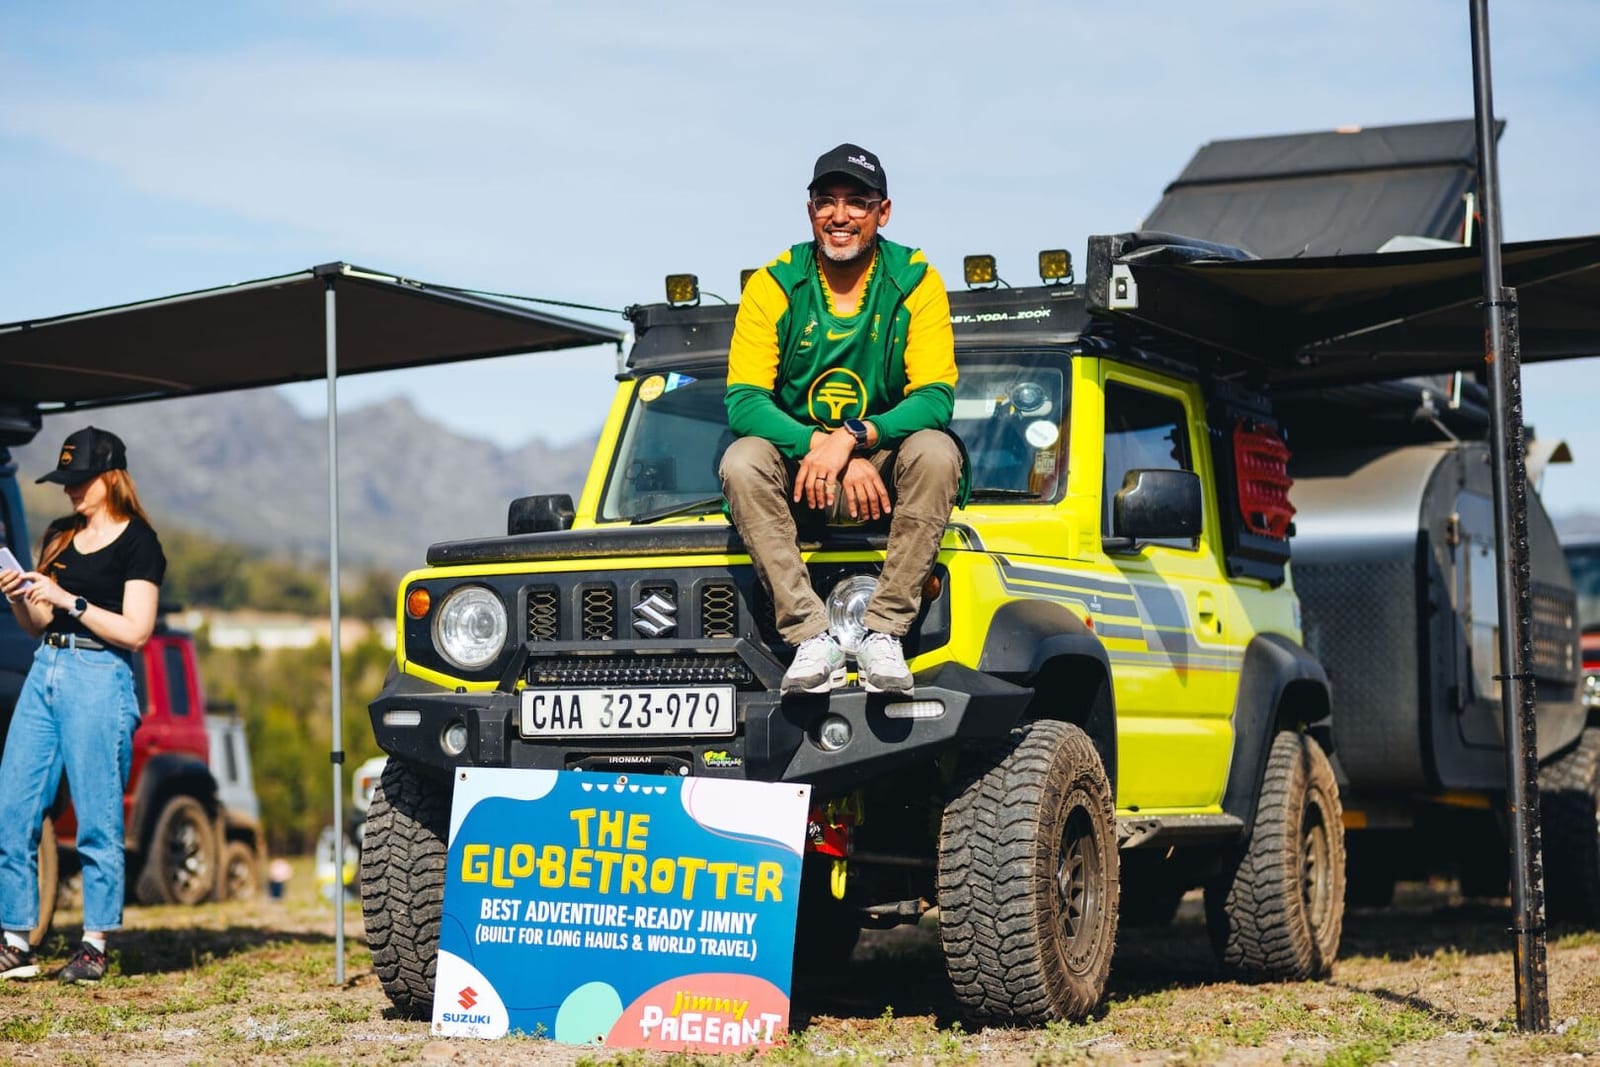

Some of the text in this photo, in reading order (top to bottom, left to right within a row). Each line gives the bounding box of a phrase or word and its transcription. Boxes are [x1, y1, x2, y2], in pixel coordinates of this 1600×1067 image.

[950, 309, 1051, 324] BY_YODA_ZOOK
[532, 692, 720, 729] CAA 323-979
[570, 808, 650, 850] THE
[461, 843, 784, 902] GLOBETROTTER
[480, 898, 758, 935] BEST ADVENTURE-READY JIMNY
[475, 923, 757, 962] (BUILT FOR LONG HAULS & WORLD TRAVEL)
[442, 1012, 491, 1025] SUZUKI
[639, 1005, 783, 1047] PAGEANT
